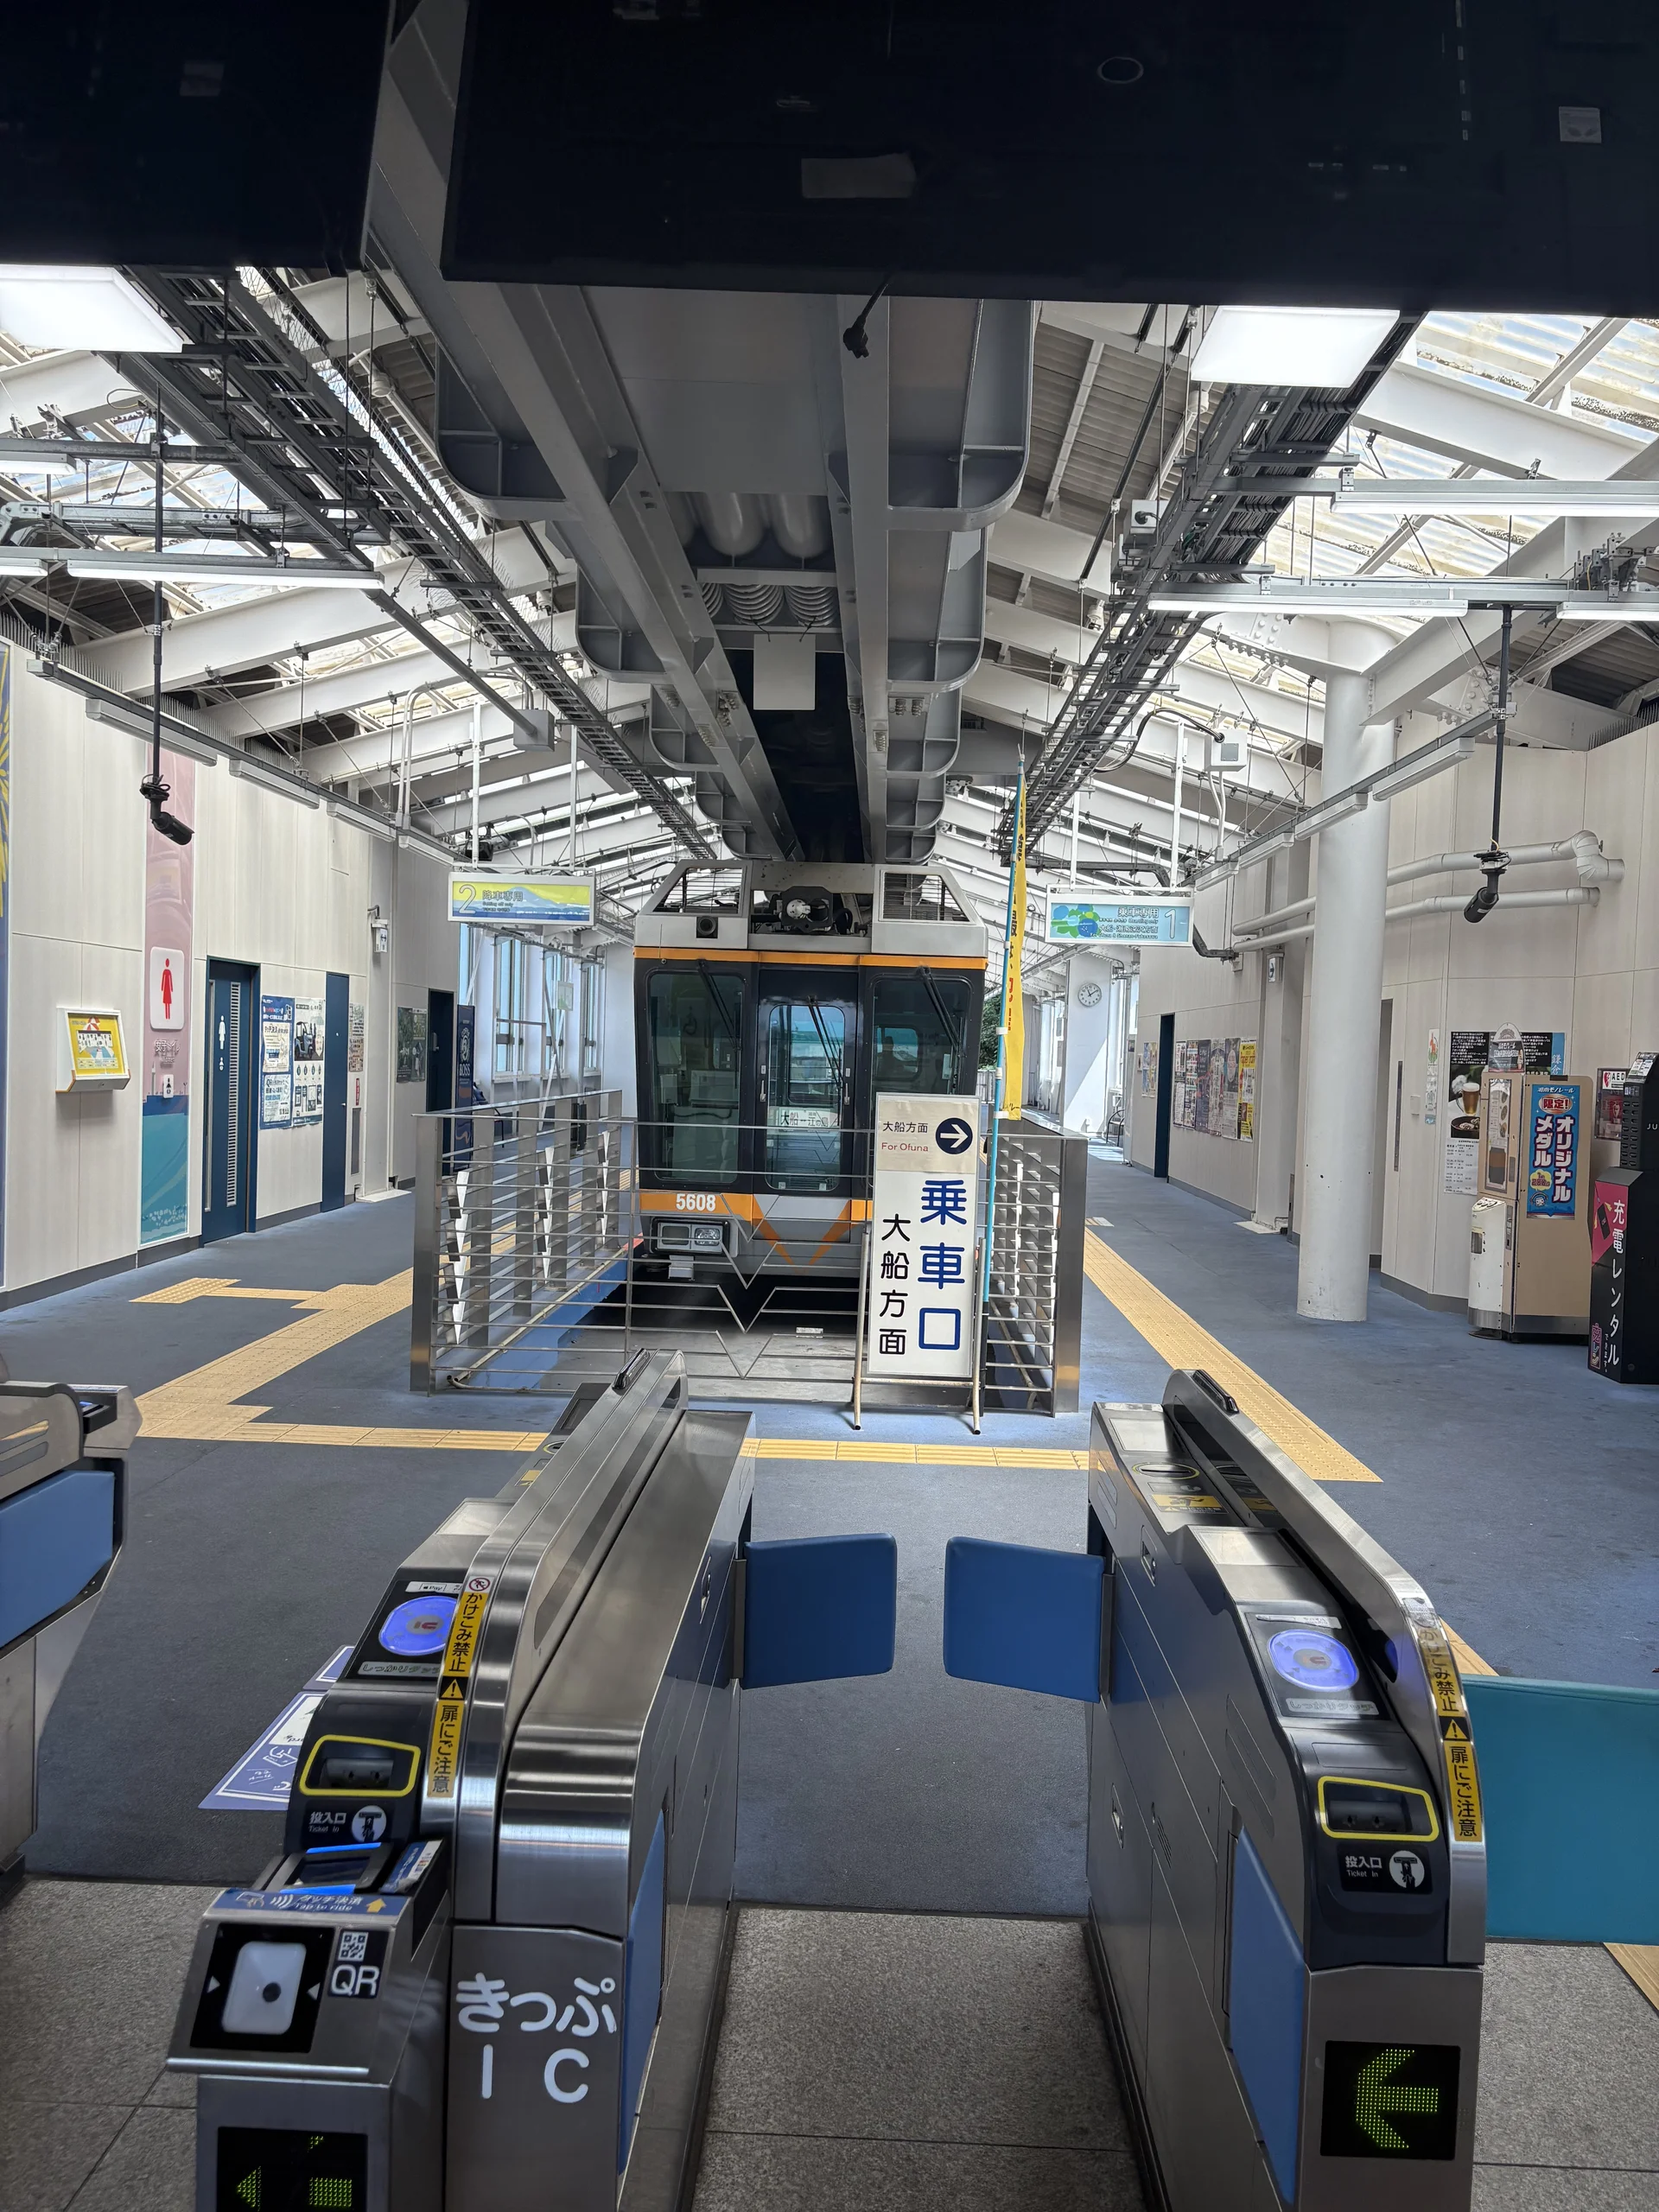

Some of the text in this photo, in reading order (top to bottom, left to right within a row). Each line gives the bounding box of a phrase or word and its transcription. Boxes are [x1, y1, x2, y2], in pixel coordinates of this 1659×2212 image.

[459, 884, 476, 914] 2
[1165, 909, 1176, 939] 1
[881, 1142, 929, 1152] For Ofuna
[882, 1121, 929, 1133] 大船方面
[1533, 1115, 1554, 1167] メダル
[1552, 1115, 1575, 1203] オリジナル
[676, 1193, 716, 1211] 5608
[879, 1214, 912, 1355] 大船方面
[918, 1179, 968, 1351] 乗車口
[1608, 1199, 1625, 1366] 充電レンタル
[448, 1592, 483, 1673] かけこみ禁止
[432, 1705, 459, 1795] 扉にご注意
[308, 1811, 347, 1825] 投入口
[1450, 1746, 1478, 1839] 扉にご注意
[1344, 1855, 1382, 1868] 投入口
[331, 1965, 380, 1998] QR
[456, 1973, 617, 2037] きっぷ
